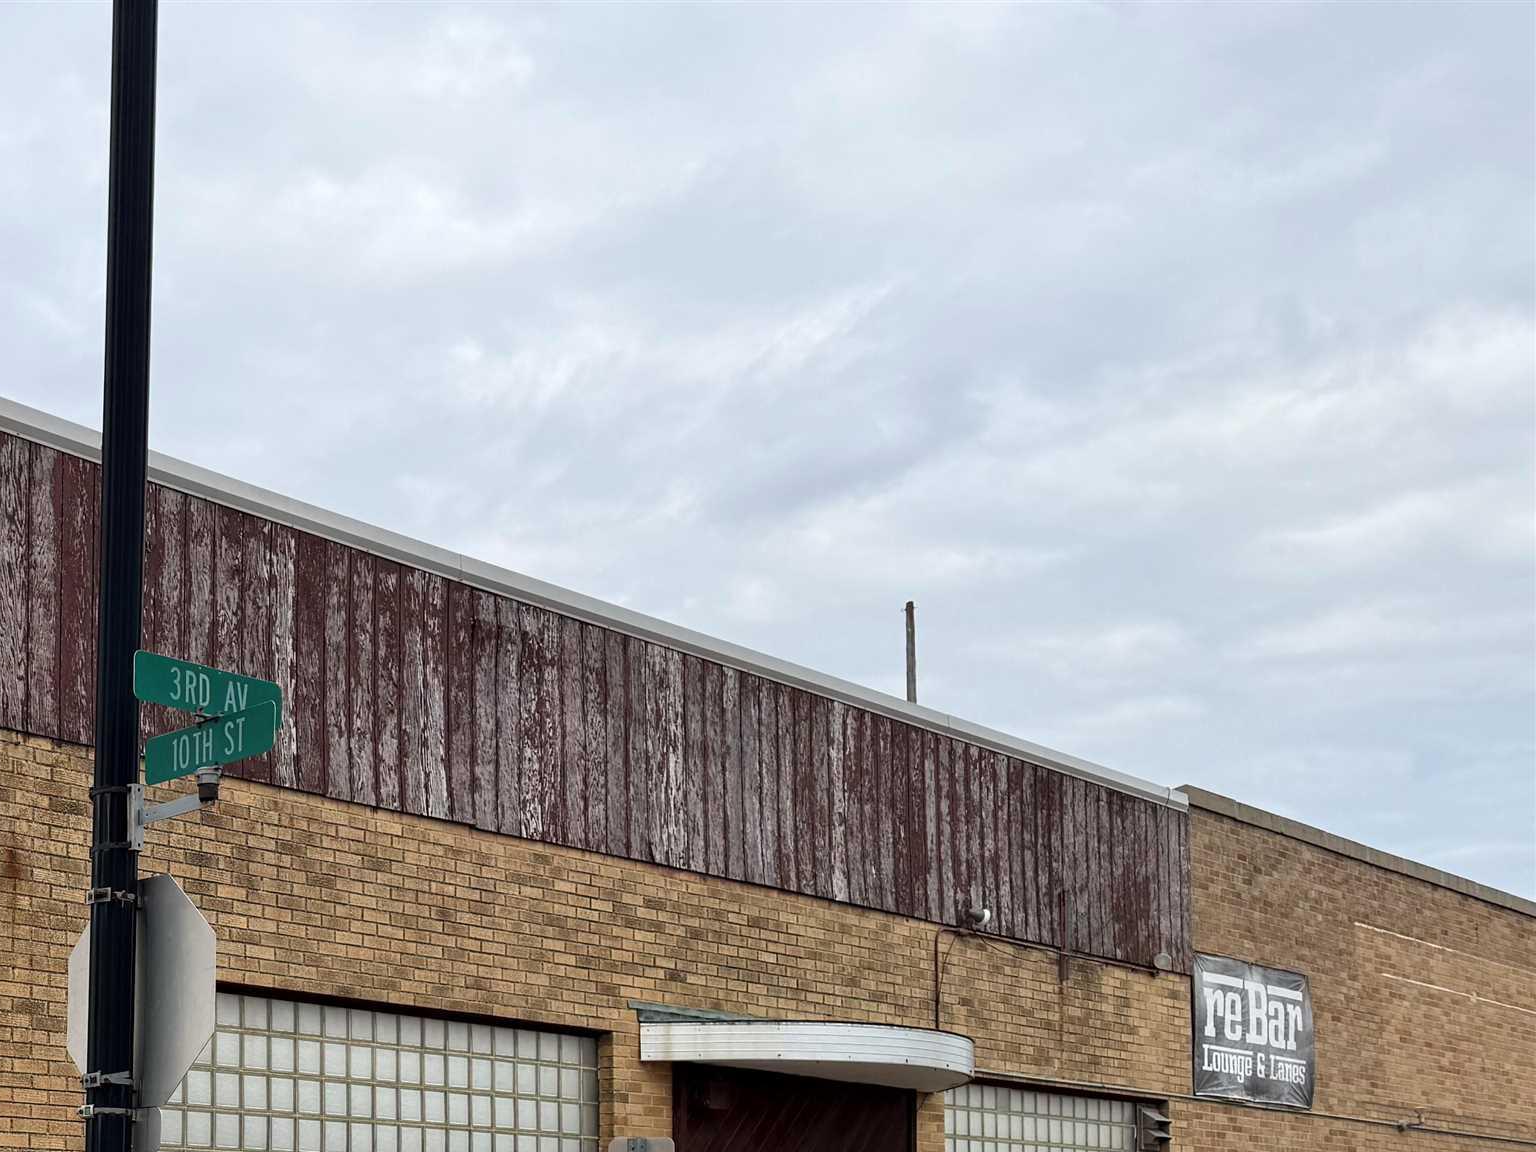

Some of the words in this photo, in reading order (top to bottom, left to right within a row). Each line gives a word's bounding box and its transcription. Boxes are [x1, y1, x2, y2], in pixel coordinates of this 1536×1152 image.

[169, 666, 210, 707] 3RD
[223, 680, 248, 713] AV
[172, 727, 213, 772] 10TH
[224, 716, 246, 756] ST
[1202, 978, 1303, 1051] reBar
[1202, 1044, 1253, 1083] Lounge
[1256, 1052, 1266, 1079] &
[1269, 1054, 1306, 1085] Lanes
